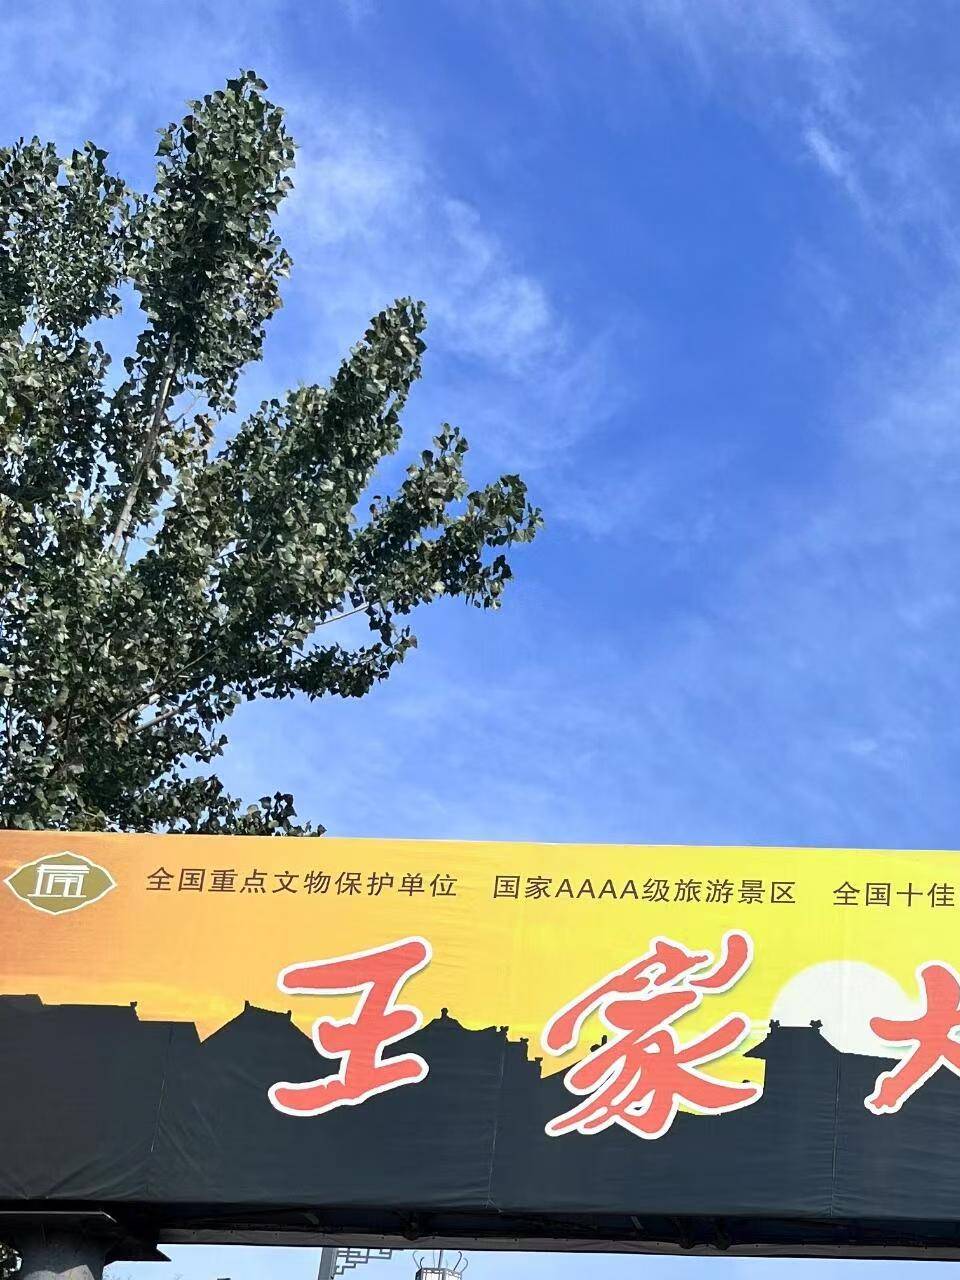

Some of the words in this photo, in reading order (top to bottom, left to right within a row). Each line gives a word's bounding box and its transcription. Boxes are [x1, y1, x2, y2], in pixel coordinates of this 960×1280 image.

[146, 867, 458, 897] 全国重点文物保护单位
[493, 875, 796, 904] 国家AAAA级旅游景区
